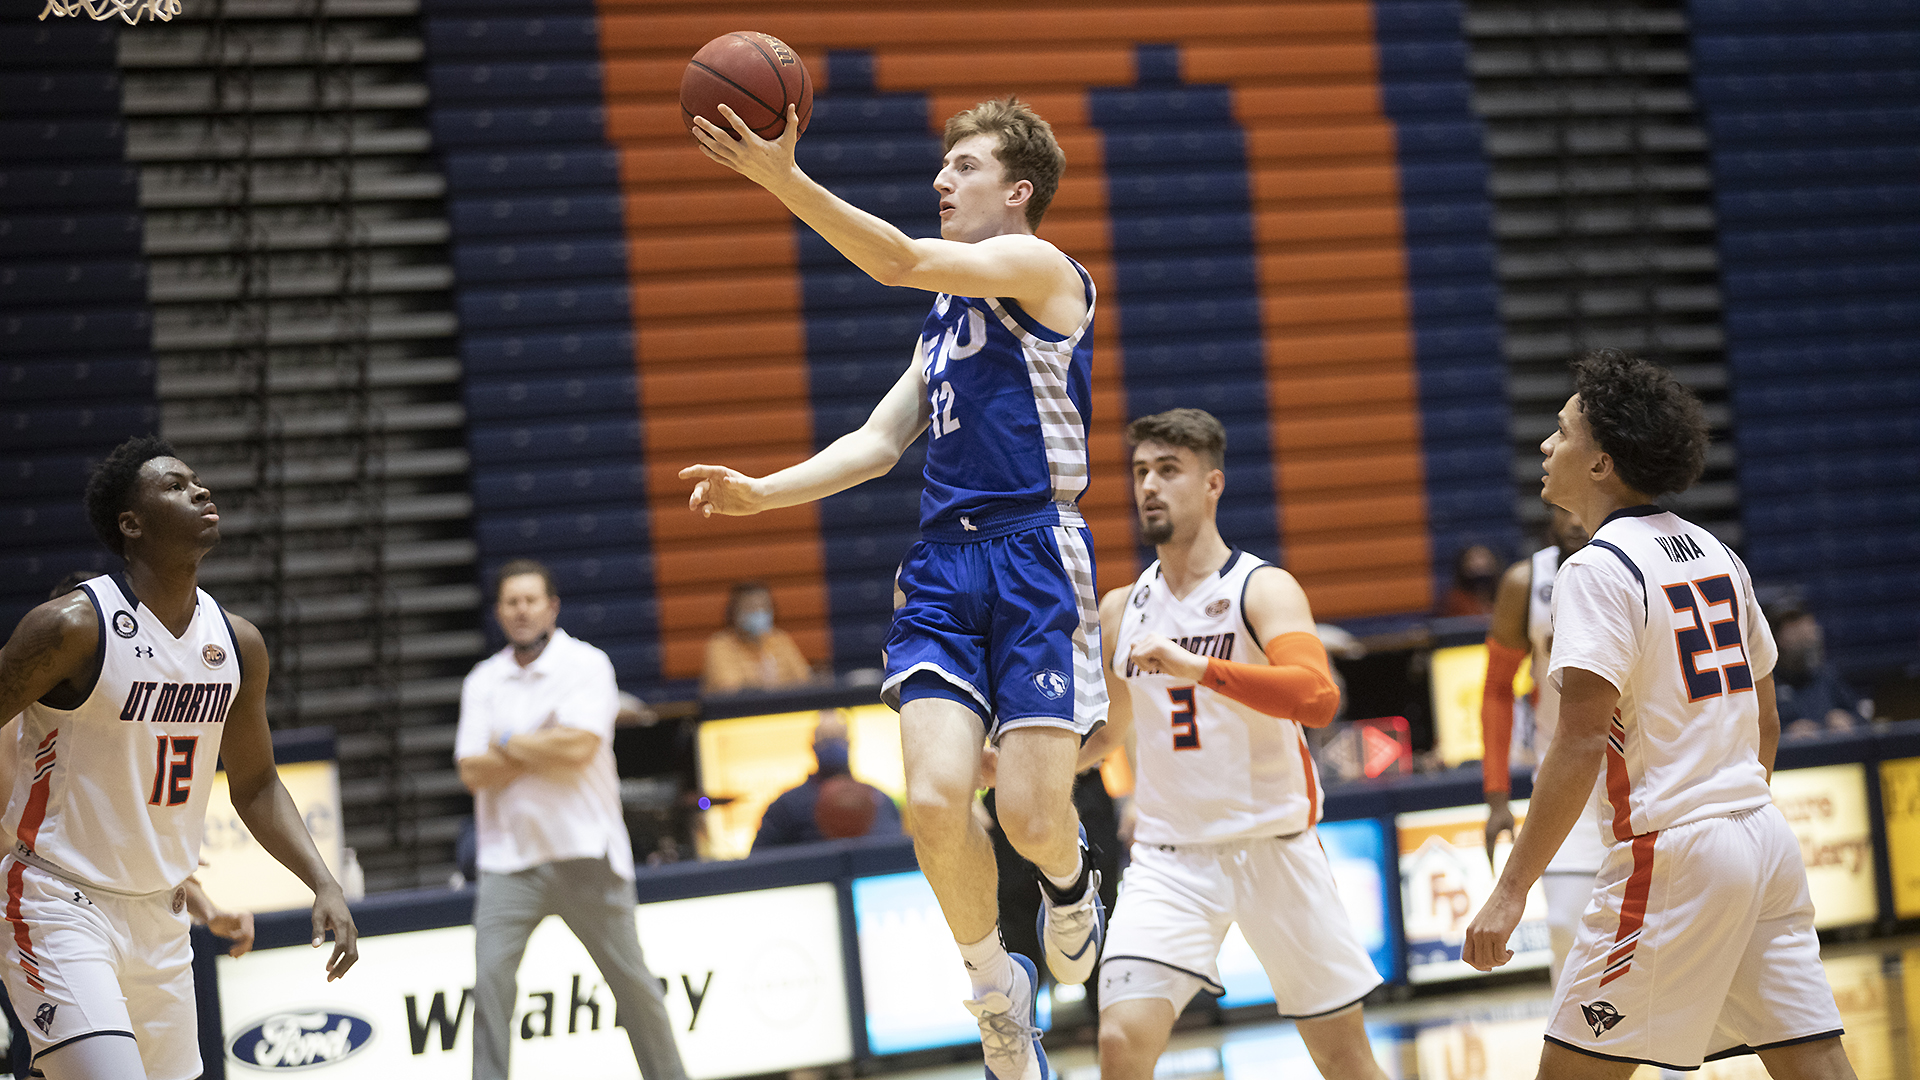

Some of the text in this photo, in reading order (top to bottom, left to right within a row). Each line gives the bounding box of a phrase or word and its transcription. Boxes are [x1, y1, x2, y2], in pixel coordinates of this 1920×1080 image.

[931, 381, 961, 440] 12
[1660, 573, 1753, 703] 23
[119, 681, 232, 722] UT MARTIN
[1167, 686, 1202, 751] 3
[148, 735, 199, 807] 12
[254, 1013, 352, 1068] Ford
[405, 971, 713, 1056] Waky
